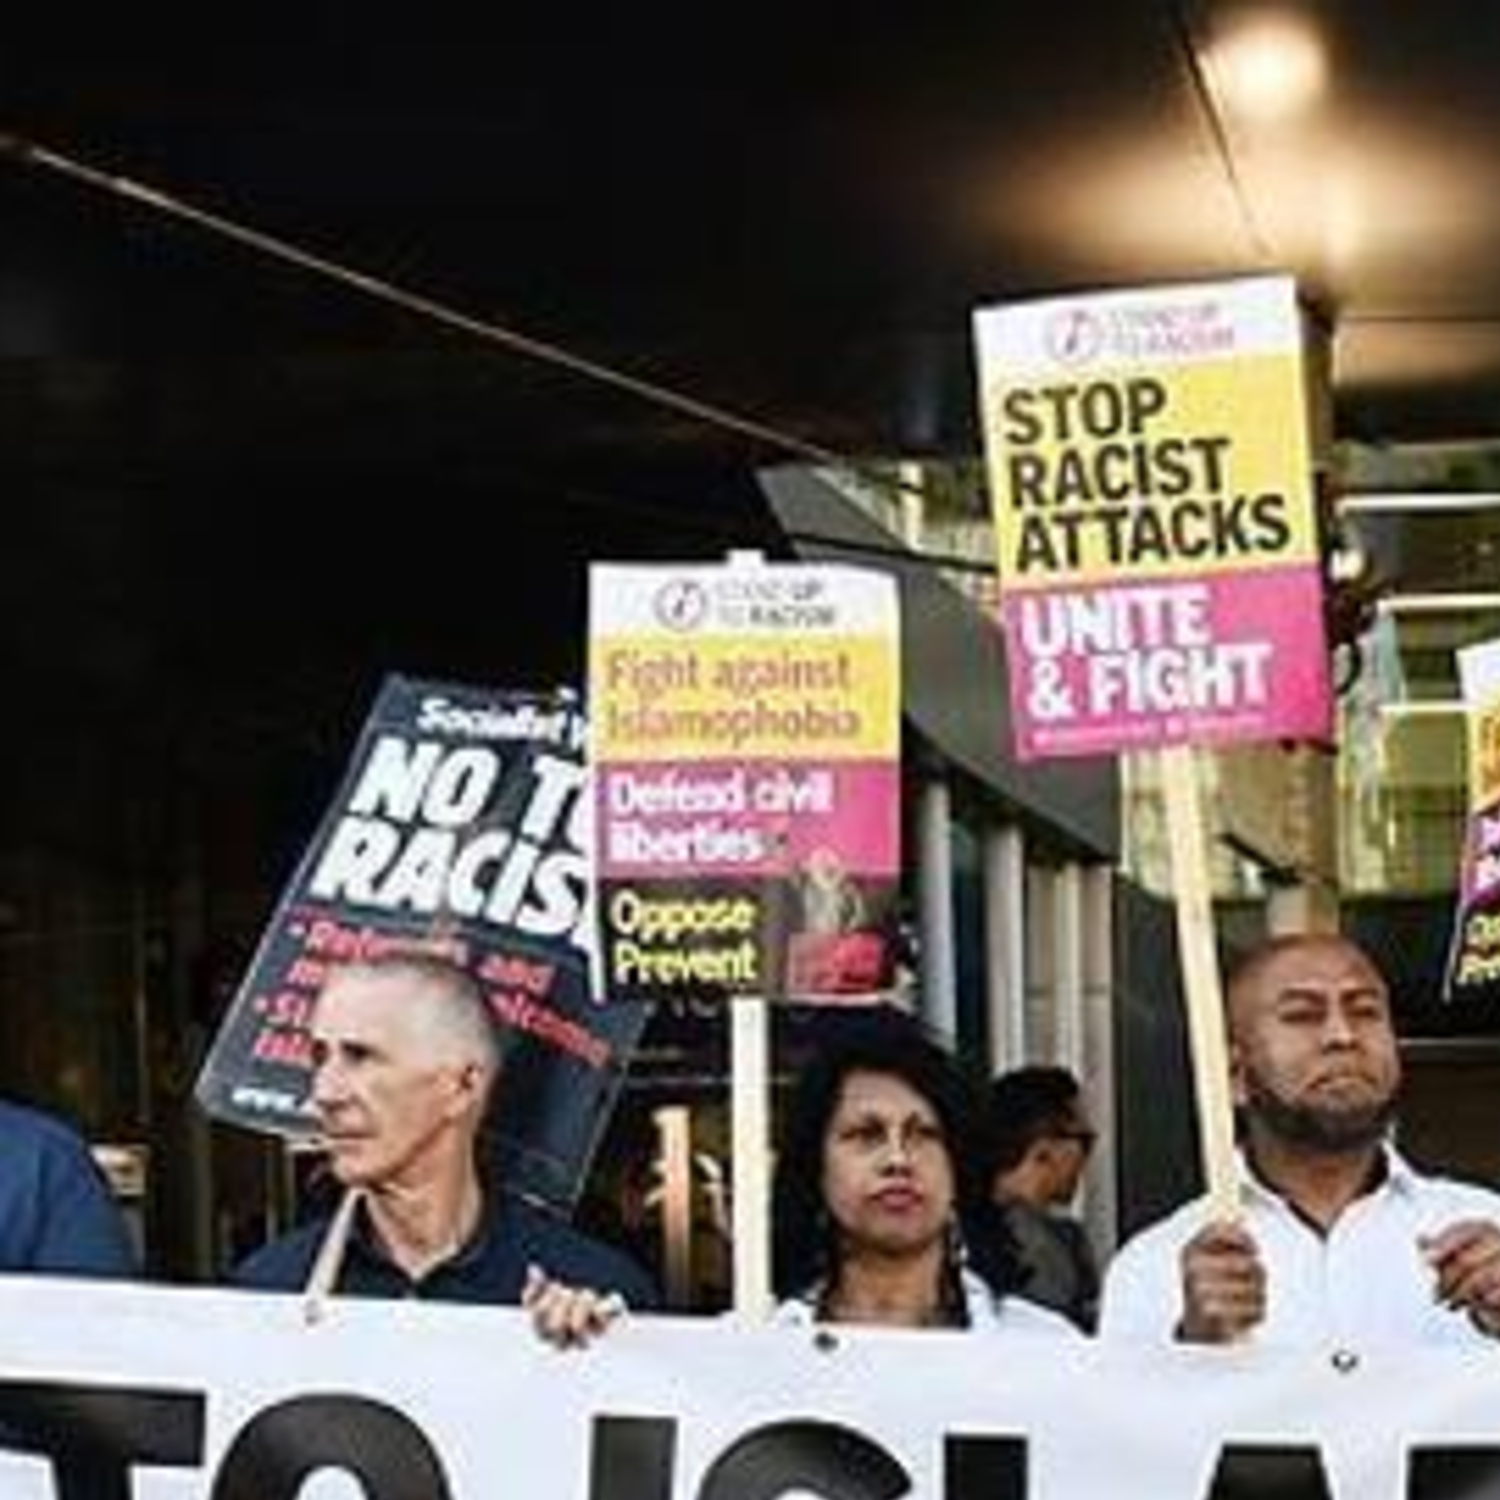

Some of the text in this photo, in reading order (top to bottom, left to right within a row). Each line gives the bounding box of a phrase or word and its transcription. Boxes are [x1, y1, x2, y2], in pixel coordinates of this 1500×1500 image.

[1003, 379, 1166, 445] STOP
[1011, 438, 1229, 507] RACIST
[1017, 495, 1290, 572] ATTACKS
[1021, 583, 1214, 656] UNITE
[608, 652, 851, 698] Fight against
[1029, 643, 1274, 719] & FIGHT
[609, 700, 861, 748] Islamophobia
[349, 736, 500, 825] NO
[609, 768, 836, 815] Defend civil
[609, 820, 766, 864] liberties
[309, 817, 592, 958] RACIS
[611, 888, 756, 944] Oppose
[612, 940, 758, 984] Prevent
